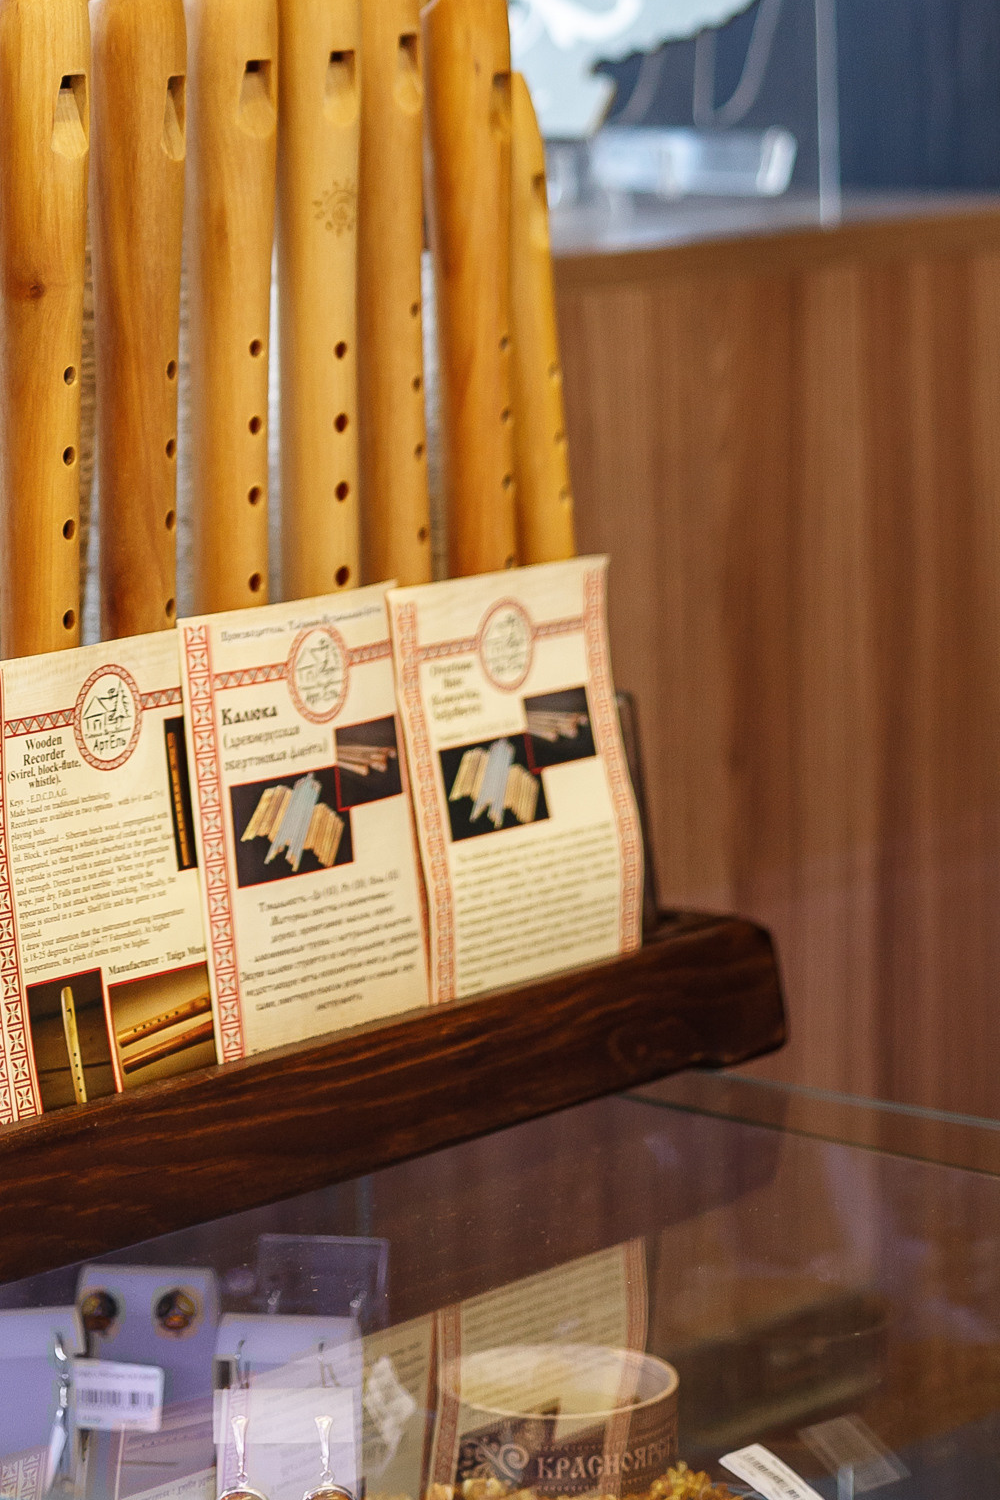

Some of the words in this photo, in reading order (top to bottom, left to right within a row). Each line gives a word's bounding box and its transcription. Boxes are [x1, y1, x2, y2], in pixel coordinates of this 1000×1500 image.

[220, 705, 278, 726] Калюка
[24, 734, 62, 751] Wooden
[22, 747, 65, 766] Recorder
[28, 773, 61, 788] whistle).
